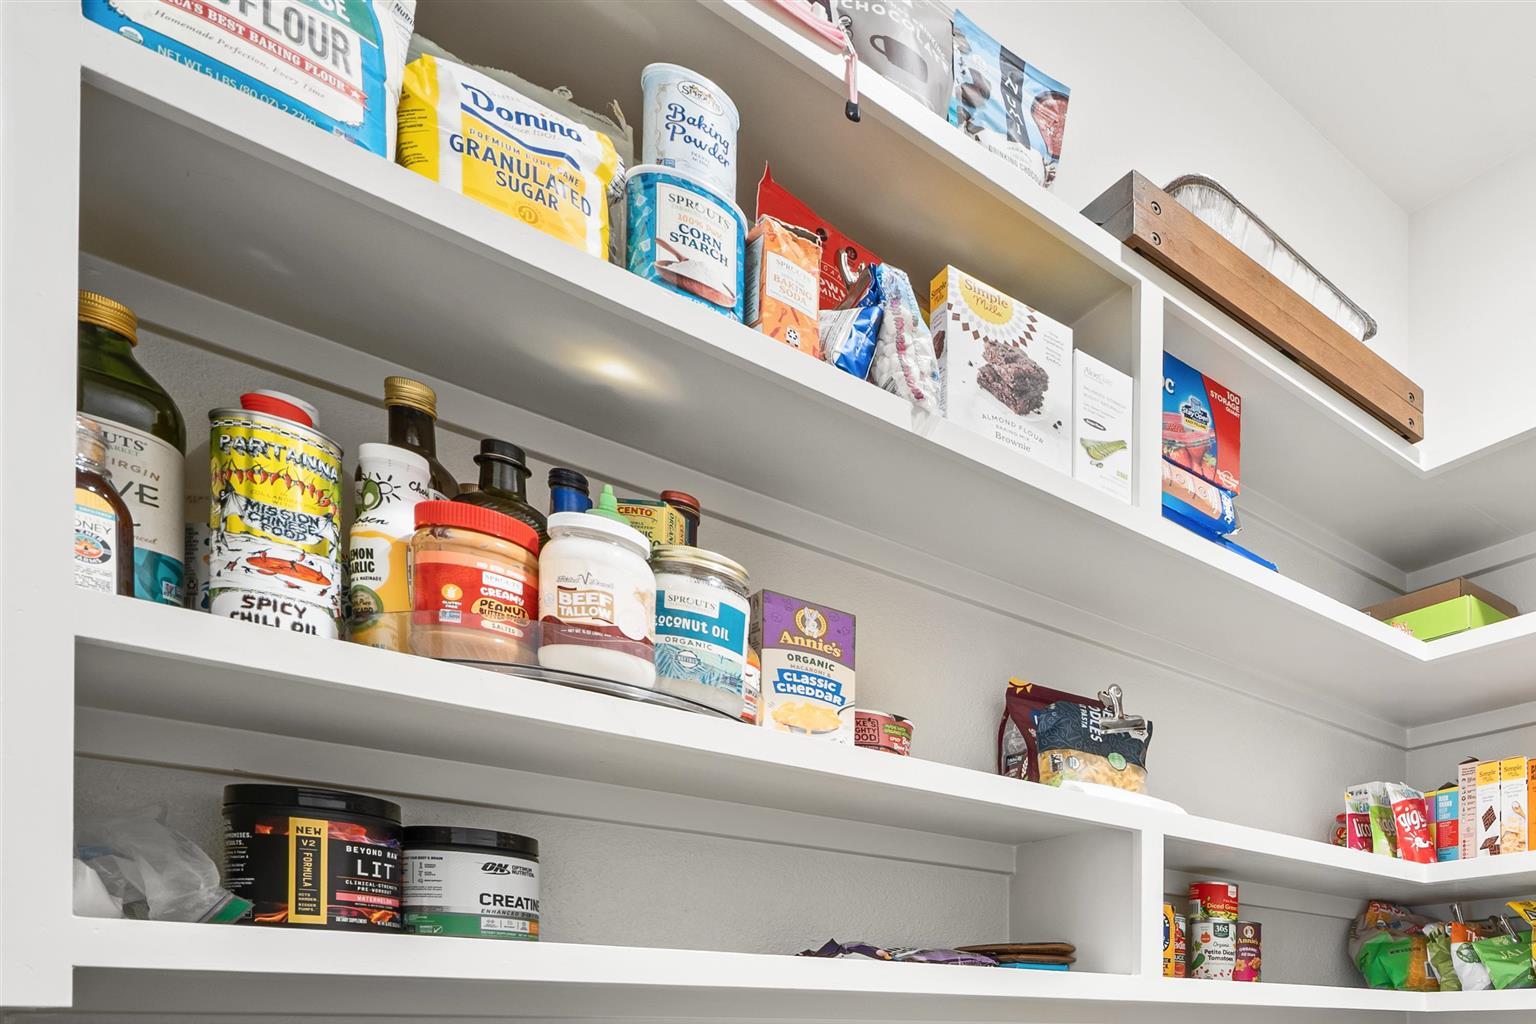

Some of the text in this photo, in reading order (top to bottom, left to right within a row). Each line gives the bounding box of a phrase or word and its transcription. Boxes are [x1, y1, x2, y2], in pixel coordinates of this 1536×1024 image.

[154, 8, 215, 42] Homemade
[206, 11, 346, 93] BEST BAKING FLOUR
[460, 82, 584, 144] Domino
[665, 102, 731, 156] Baking
[664, 121, 730, 168] Powder
[469, 127, 580, 187] PREMIUM CANE
[449, 133, 592, 217] GRANULATED
[496, 170, 559, 212] SUGAR
[667, 192, 731, 231] SPROUTS
[678, 223, 723, 253] CORN
[669, 232, 729, 268] STARCH
[773, 273, 814, 303] BAKING
[779, 285, 808, 308] SODA
[963, 277, 1010, 309] Simple
[1210, 389, 1241, 413] STORAGE
[1227, 390, 1241, 406] 100
[981, 413, 1018, 432] ALMOND
[994, 431, 1032, 453] Brownie
[218, 434, 339, 486] PARTANNA
[243, 500, 320, 527] MISSION
[616, 505, 654, 518] CENTO
[248, 512, 317, 535] CHINESE
[260, 525, 307, 542] FOOD
[241, 593, 308, 618] SPICY
[479, 587, 525, 606] CREAMY
[558, 590, 613, 609] BEEF
[667, 593, 717, 611] SPROUTS
[479, 599, 528, 619] PEANUT
[558, 604, 612, 620] TALLOW
[230, 611, 321, 637] CHILI OIL
[655, 614, 730, 642] COCONUT OIL
[664, 635, 713, 652] ORGANIC
[779, 630, 842, 659] Annie's
[786, 652, 836, 672] ORGANIC
[296, 825, 322, 836] NEW
[301, 839, 316, 848] V2
[345, 845, 383, 857] BEYOND
[302, 852, 313, 888] FORMULA
[356, 859, 394, 880] LIT
[345, 879, 398, 891] CLINICAL-STRENGTH
[357, 886, 393, 896] PRE-WORKOUT
[479, 892, 540, 913] CREATINE
[480, 908, 520, 917] ENHANCED
[1214, 924, 1229, 933] 365
